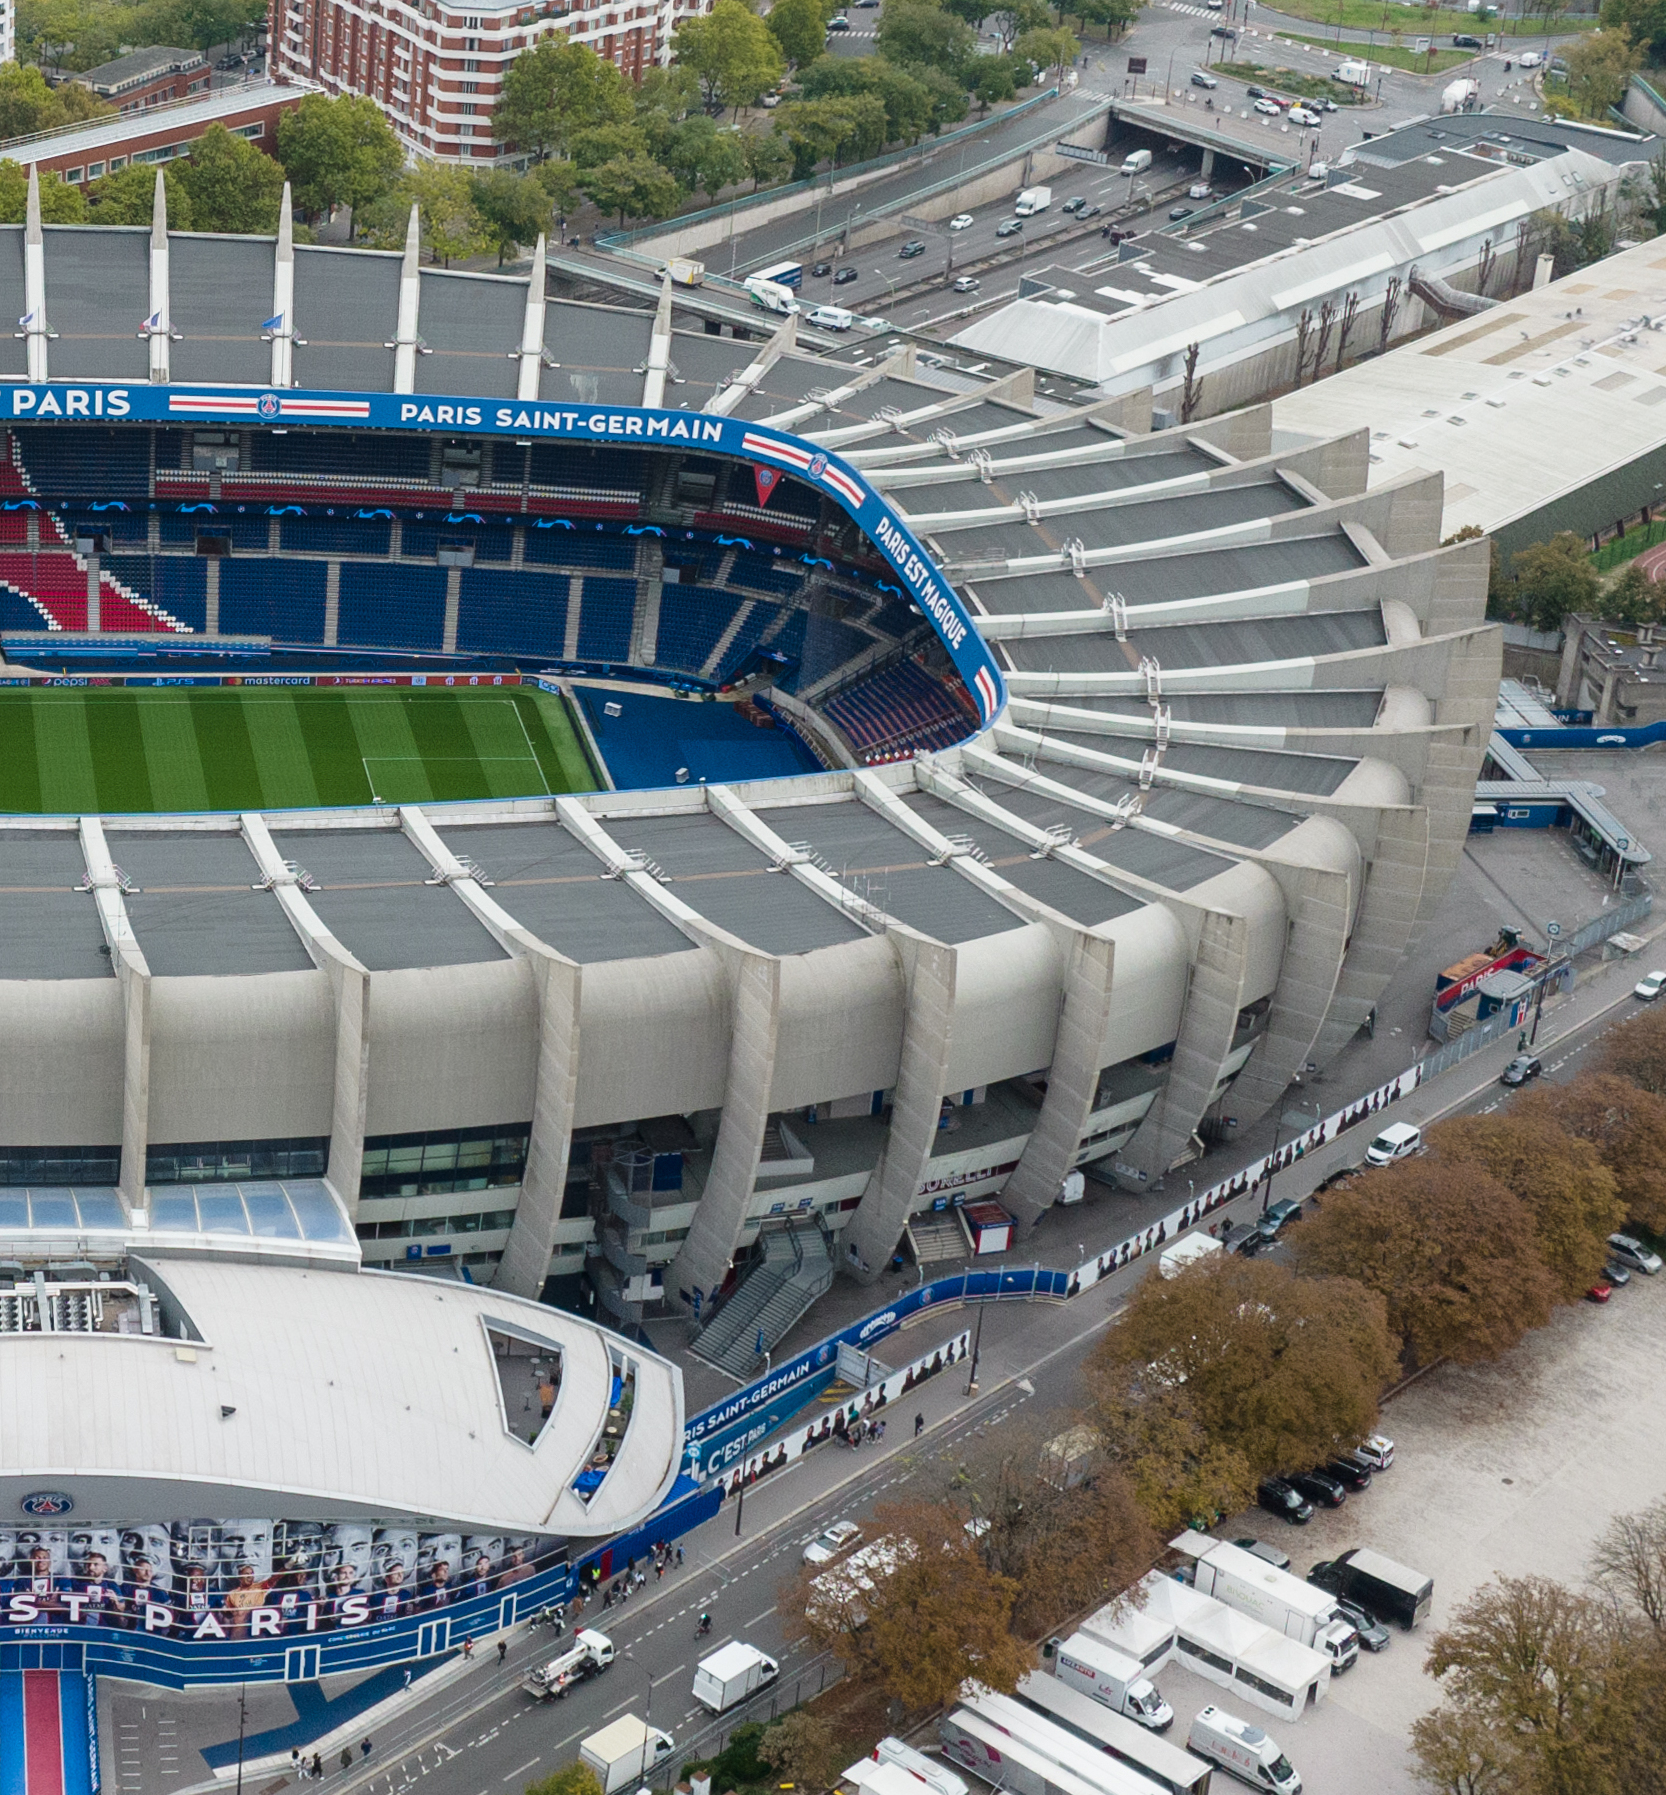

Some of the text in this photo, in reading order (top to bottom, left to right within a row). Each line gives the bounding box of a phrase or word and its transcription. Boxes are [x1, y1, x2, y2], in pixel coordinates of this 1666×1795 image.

[13, 389, 131, 416] PARIS
[400, 403, 723, 442] PARIS SAINT-GERMAIN
[875, 516, 967, 650] PARIS EST MAGIQUE
[53, 677, 87, 687] pepsi
[244, 676, 310, 685] mastercard
[707, 1361, 810, 1429] SAINT-GERMAIN
[15, 1627, 69, 1635] BIENVENUE
[145, 1597, 369, 1639] PARIS
